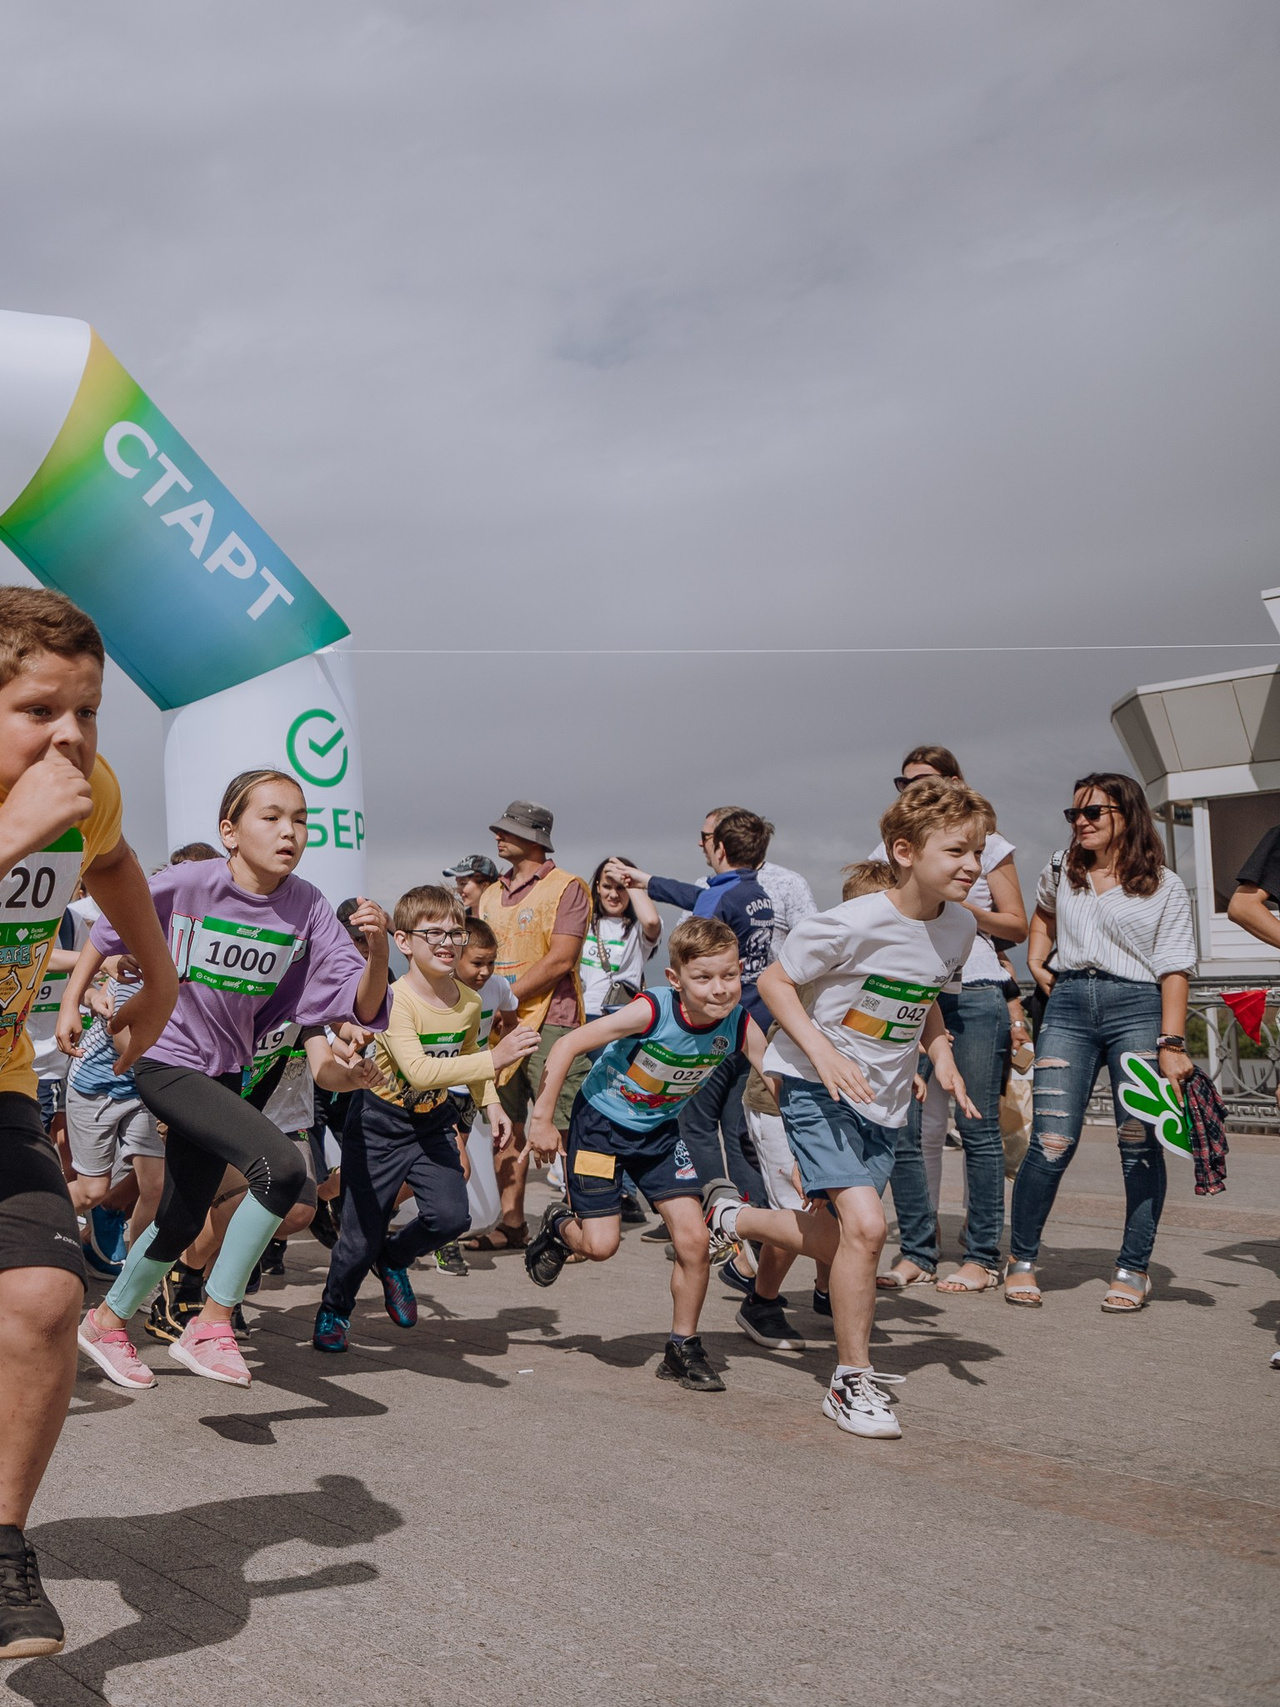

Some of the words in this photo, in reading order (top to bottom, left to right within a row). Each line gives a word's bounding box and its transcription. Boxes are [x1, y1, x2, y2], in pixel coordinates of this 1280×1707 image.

[103, 421, 295, 621] СТАРТ
[307, 807, 365, 850] БЕР
[745, 899, 773, 916] CROAT
[205, 941, 277, 975] 1000
[896, 1006, 926, 1021] 042
[672, 1070, 704, 1081] 022
